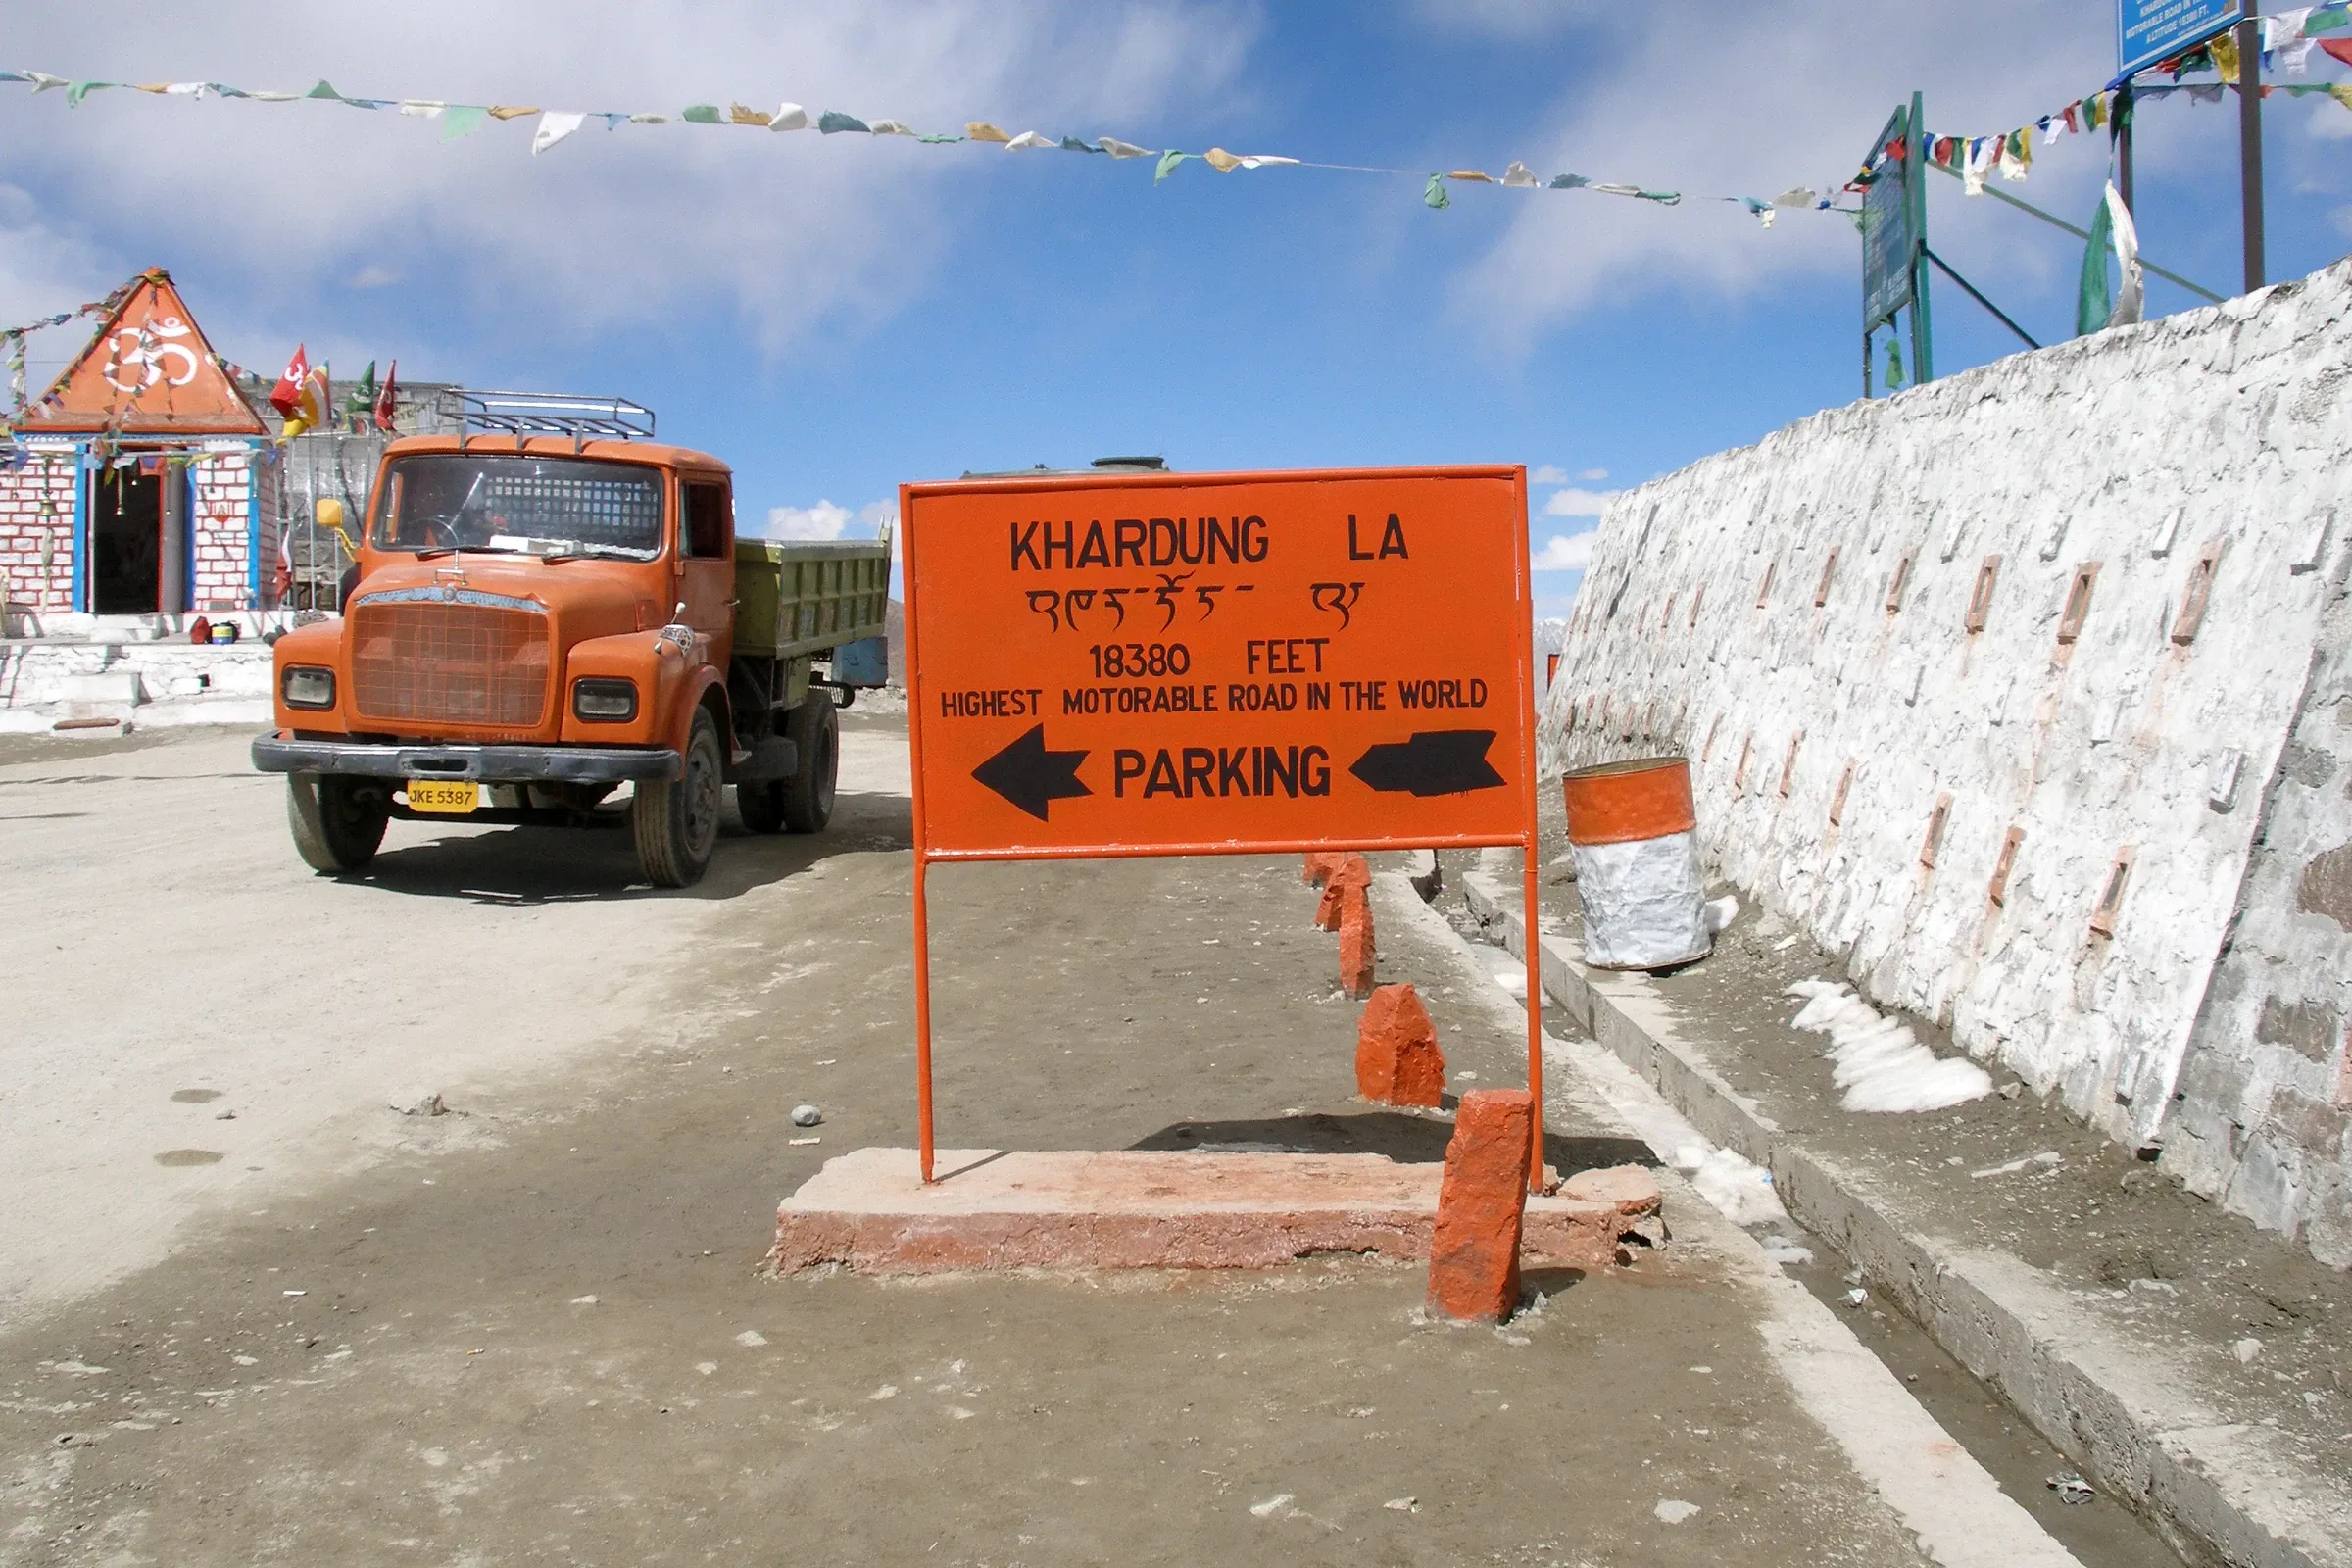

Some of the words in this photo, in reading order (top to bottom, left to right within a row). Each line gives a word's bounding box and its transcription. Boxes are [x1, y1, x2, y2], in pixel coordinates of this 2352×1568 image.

[1010, 515, 1269, 571] KHARDUNG
[1348, 513, 1409, 561] LA
[1089, 643, 1191, 678] 18380
[1247, 637, 1330, 675] FEET
[941, 689, 1043, 718] HIGHEST
[1062, 685, 1218, 714] MOTORABLE
[1228, 683, 1298, 712] ROAD
[1307, 682, 1331, 710] IN
[1340, 681, 1387, 710] THE
[1397, 678, 1488, 709] WORLD
[1113, 745, 1331, 799] PARKING
[409, 790, 433, 804] JKE
[437, 790, 473, 805] 5387
